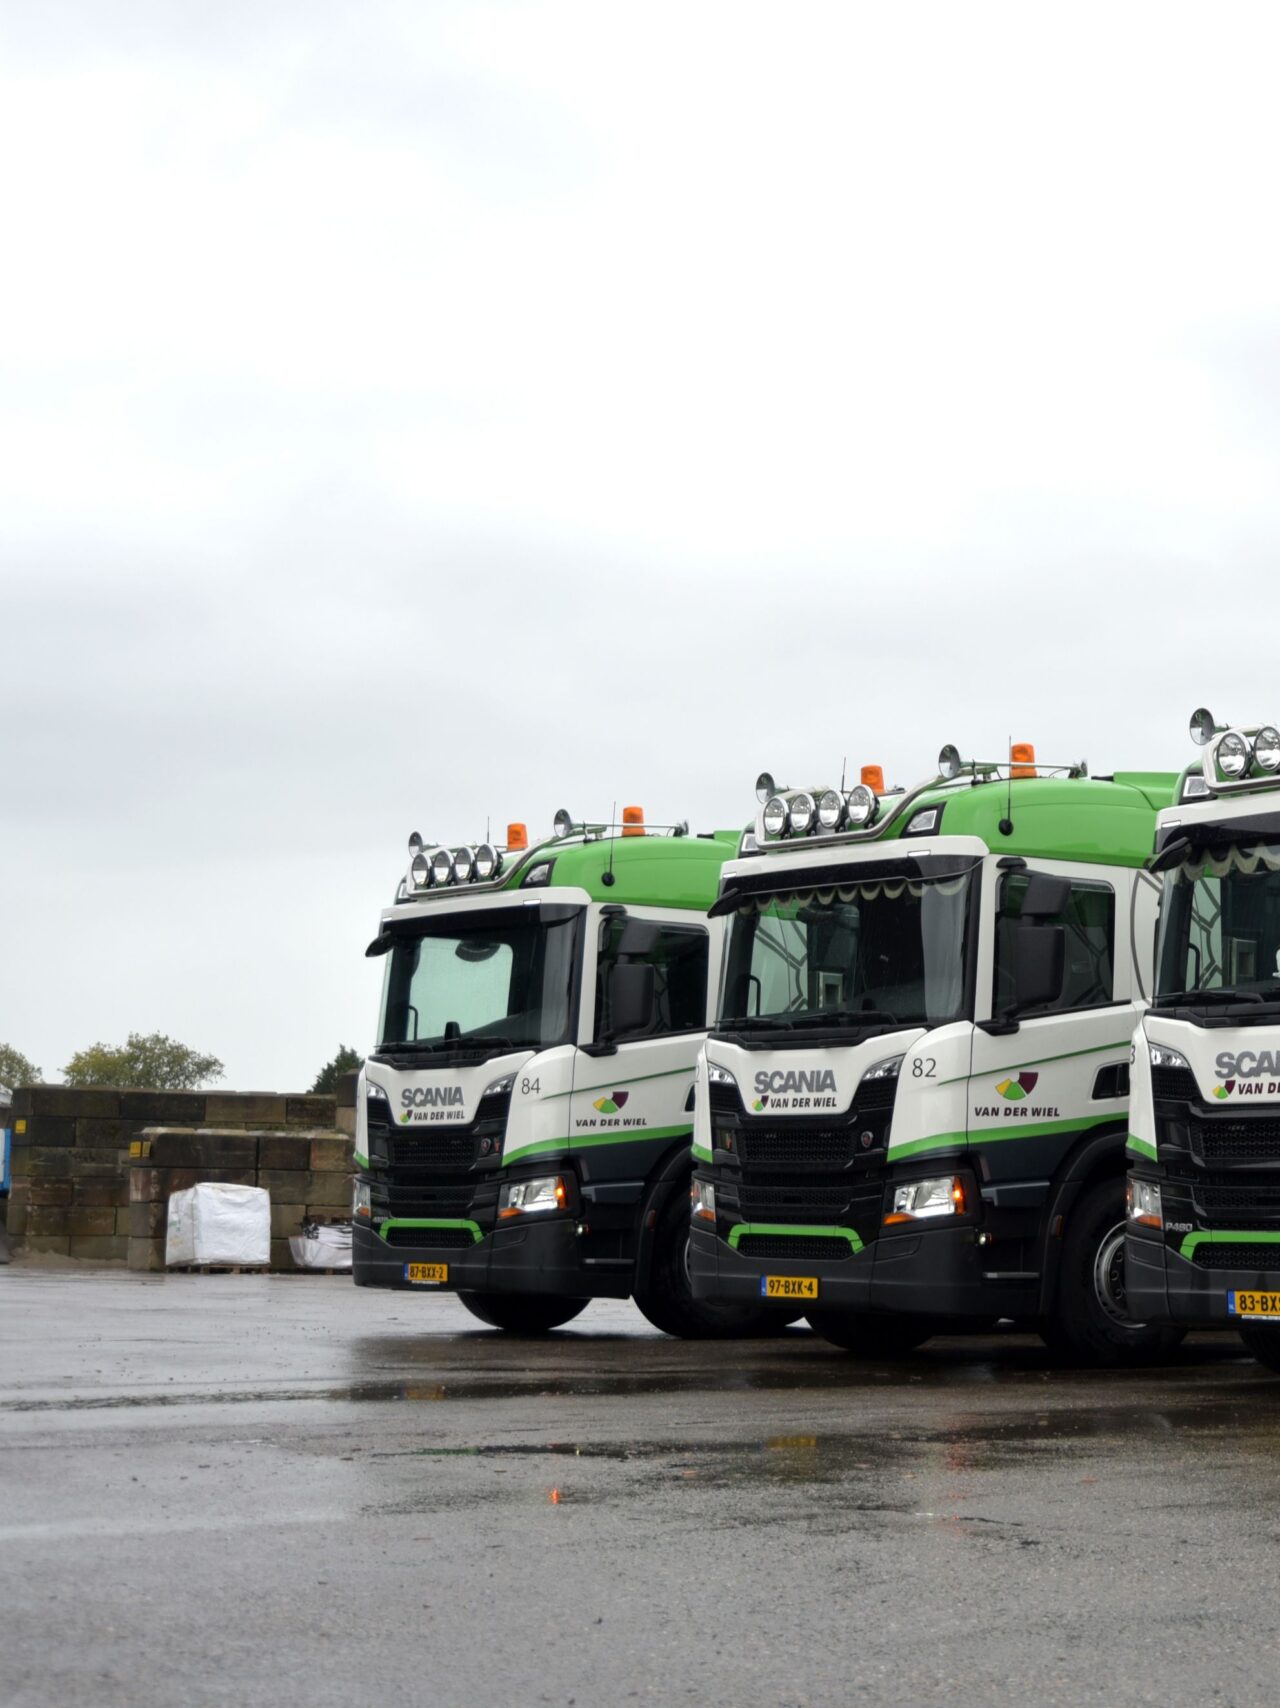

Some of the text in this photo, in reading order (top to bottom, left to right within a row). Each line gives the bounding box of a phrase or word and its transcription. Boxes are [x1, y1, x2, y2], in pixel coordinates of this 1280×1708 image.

[912, 1058, 937, 1078] 82
[521, 1077, 541, 1095] 84
[754, 1070, 837, 1094] SCANIA
[1238, 1083, 1264, 1095] VAN
[401, 1086, 464, 1108] SCANIA
[770, 1097, 837, 1108] VAN DER WIEL
[414, 1110, 465, 1120] VAN DER WIEL
[974, 1107, 1060, 1117] VAN DER WIEL
[576, 1119, 597, 1127] VAN
[623, 1118, 647, 1126] WIEL
[769, 1279, 813, 1295] 97-BXK-4
